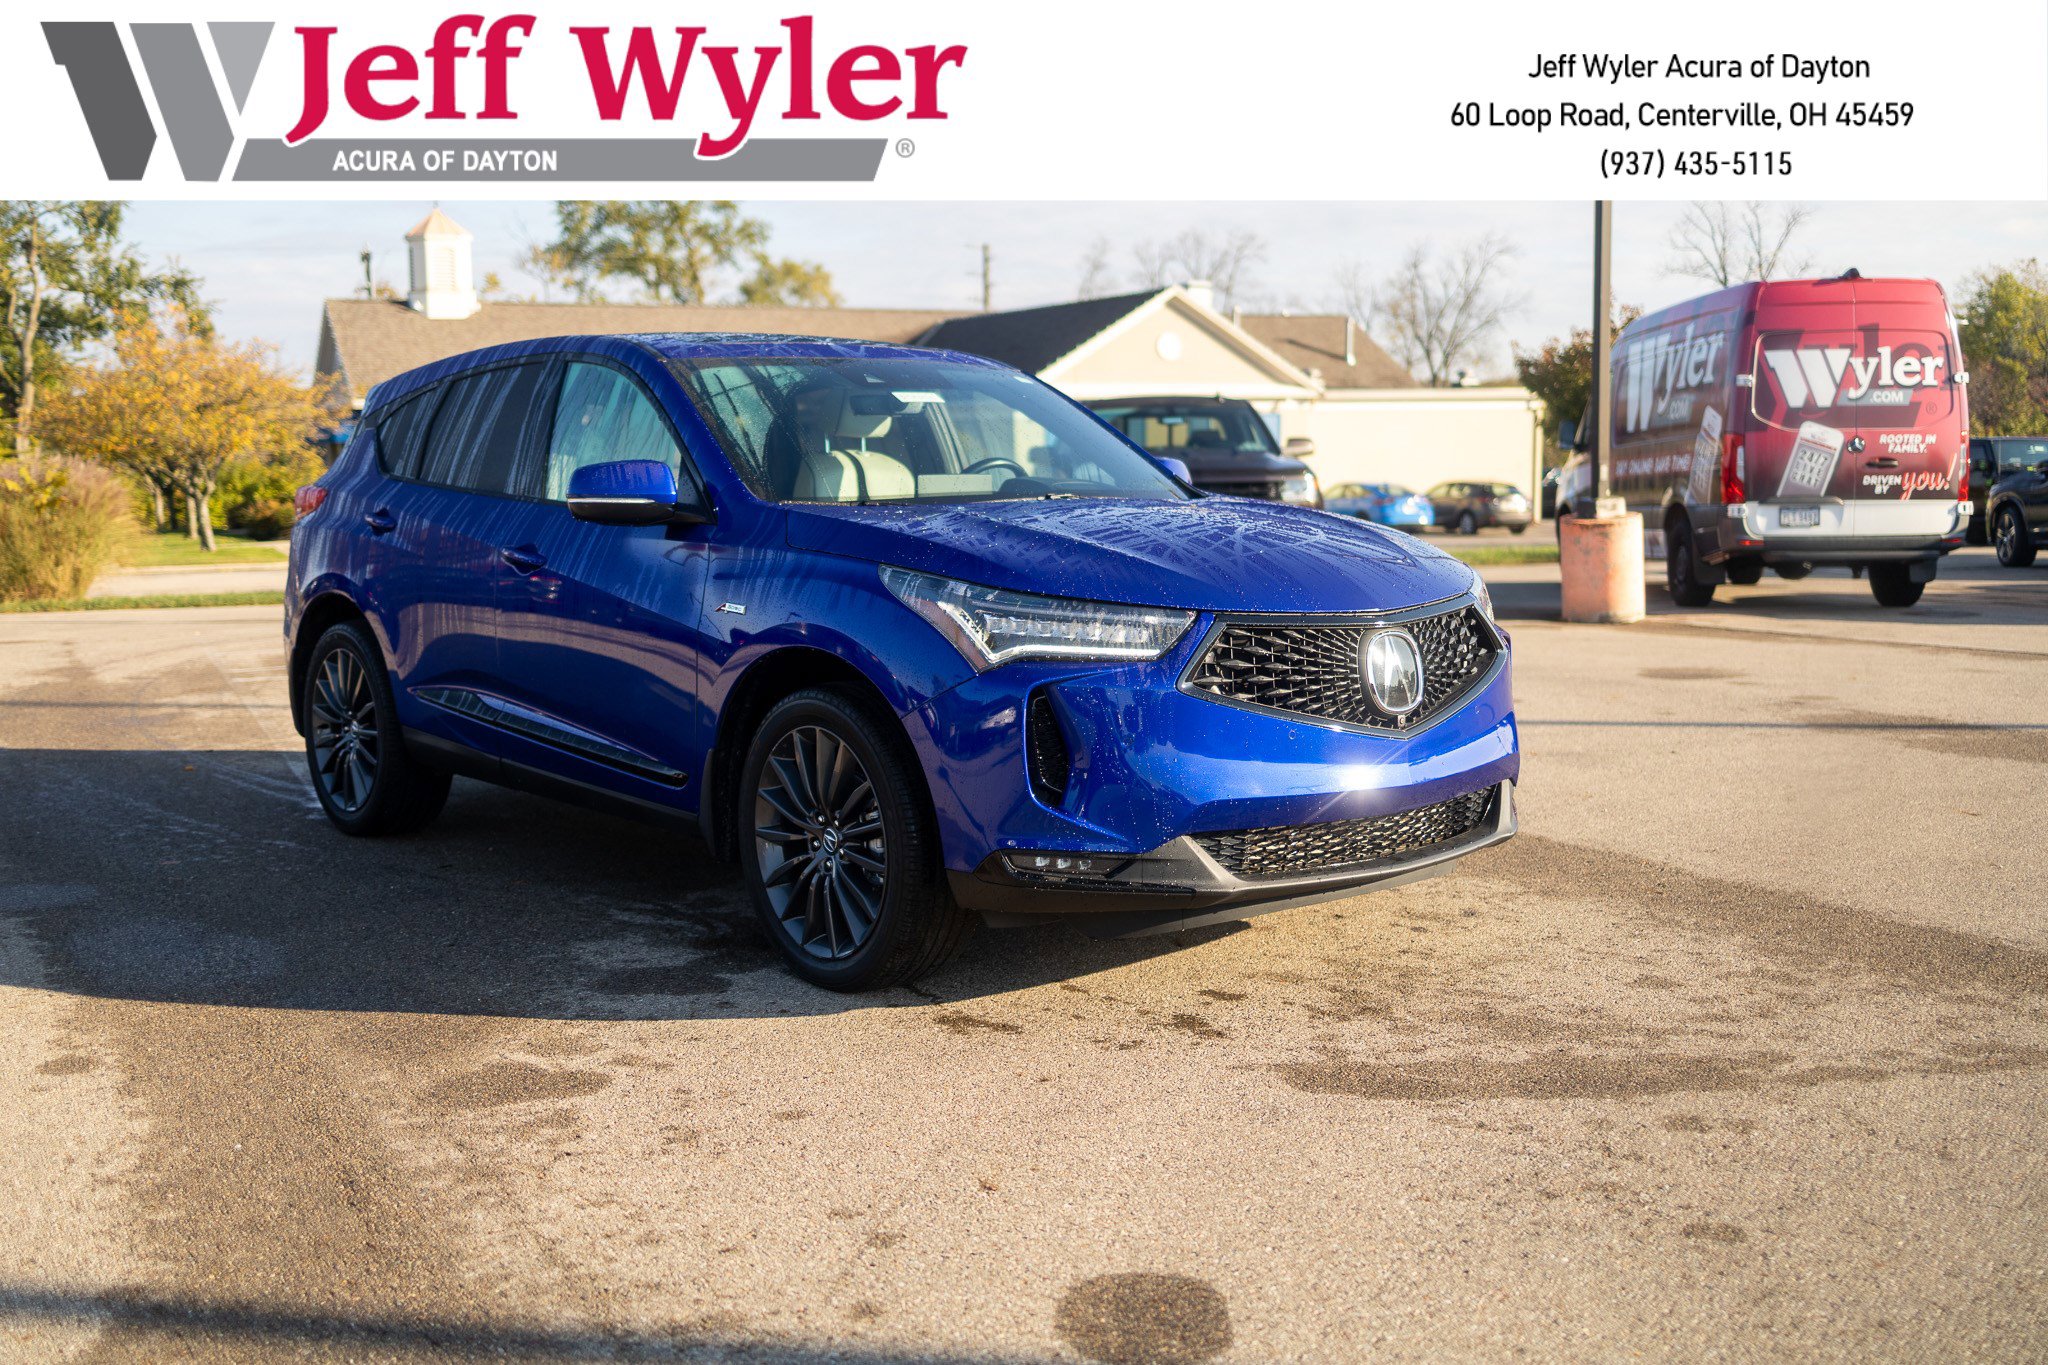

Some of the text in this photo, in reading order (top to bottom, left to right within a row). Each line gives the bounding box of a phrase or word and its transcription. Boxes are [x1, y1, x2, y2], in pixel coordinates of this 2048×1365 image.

[1626, 323, 1725, 434] Wyler
[1764, 346, 1945, 408] Wyler
[1880, 434, 1936, 444] ROOTED IN
[1863, 475, 1902, 485] DRIVEN
[1874, 485, 1890, 495] BY
